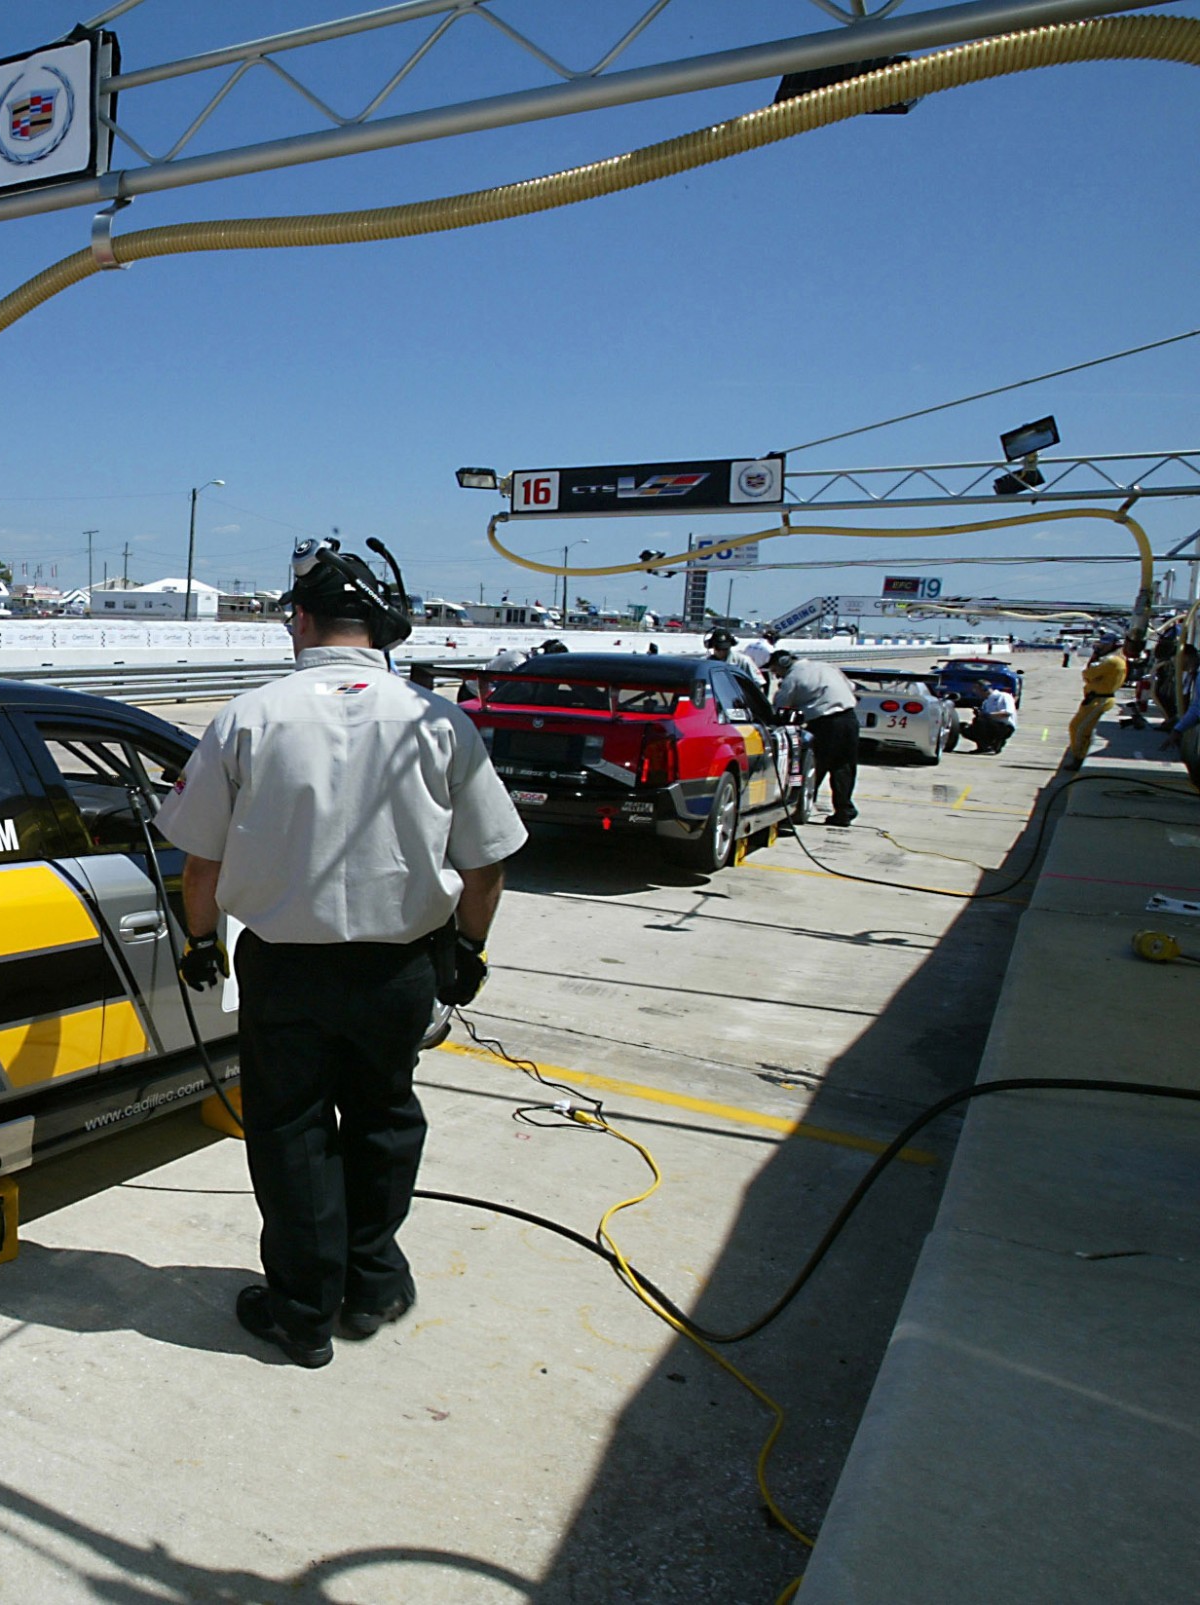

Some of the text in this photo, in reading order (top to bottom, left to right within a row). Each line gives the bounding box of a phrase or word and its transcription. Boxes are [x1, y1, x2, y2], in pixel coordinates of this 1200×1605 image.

[522, 478, 550, 505] 16
[920, 578, 942, 598] 19
[774, 605, 817, 632] SEBRING
[887, 716, 908, 728] 34
[85, 1079, 205, 1131] www.cadillac.com
